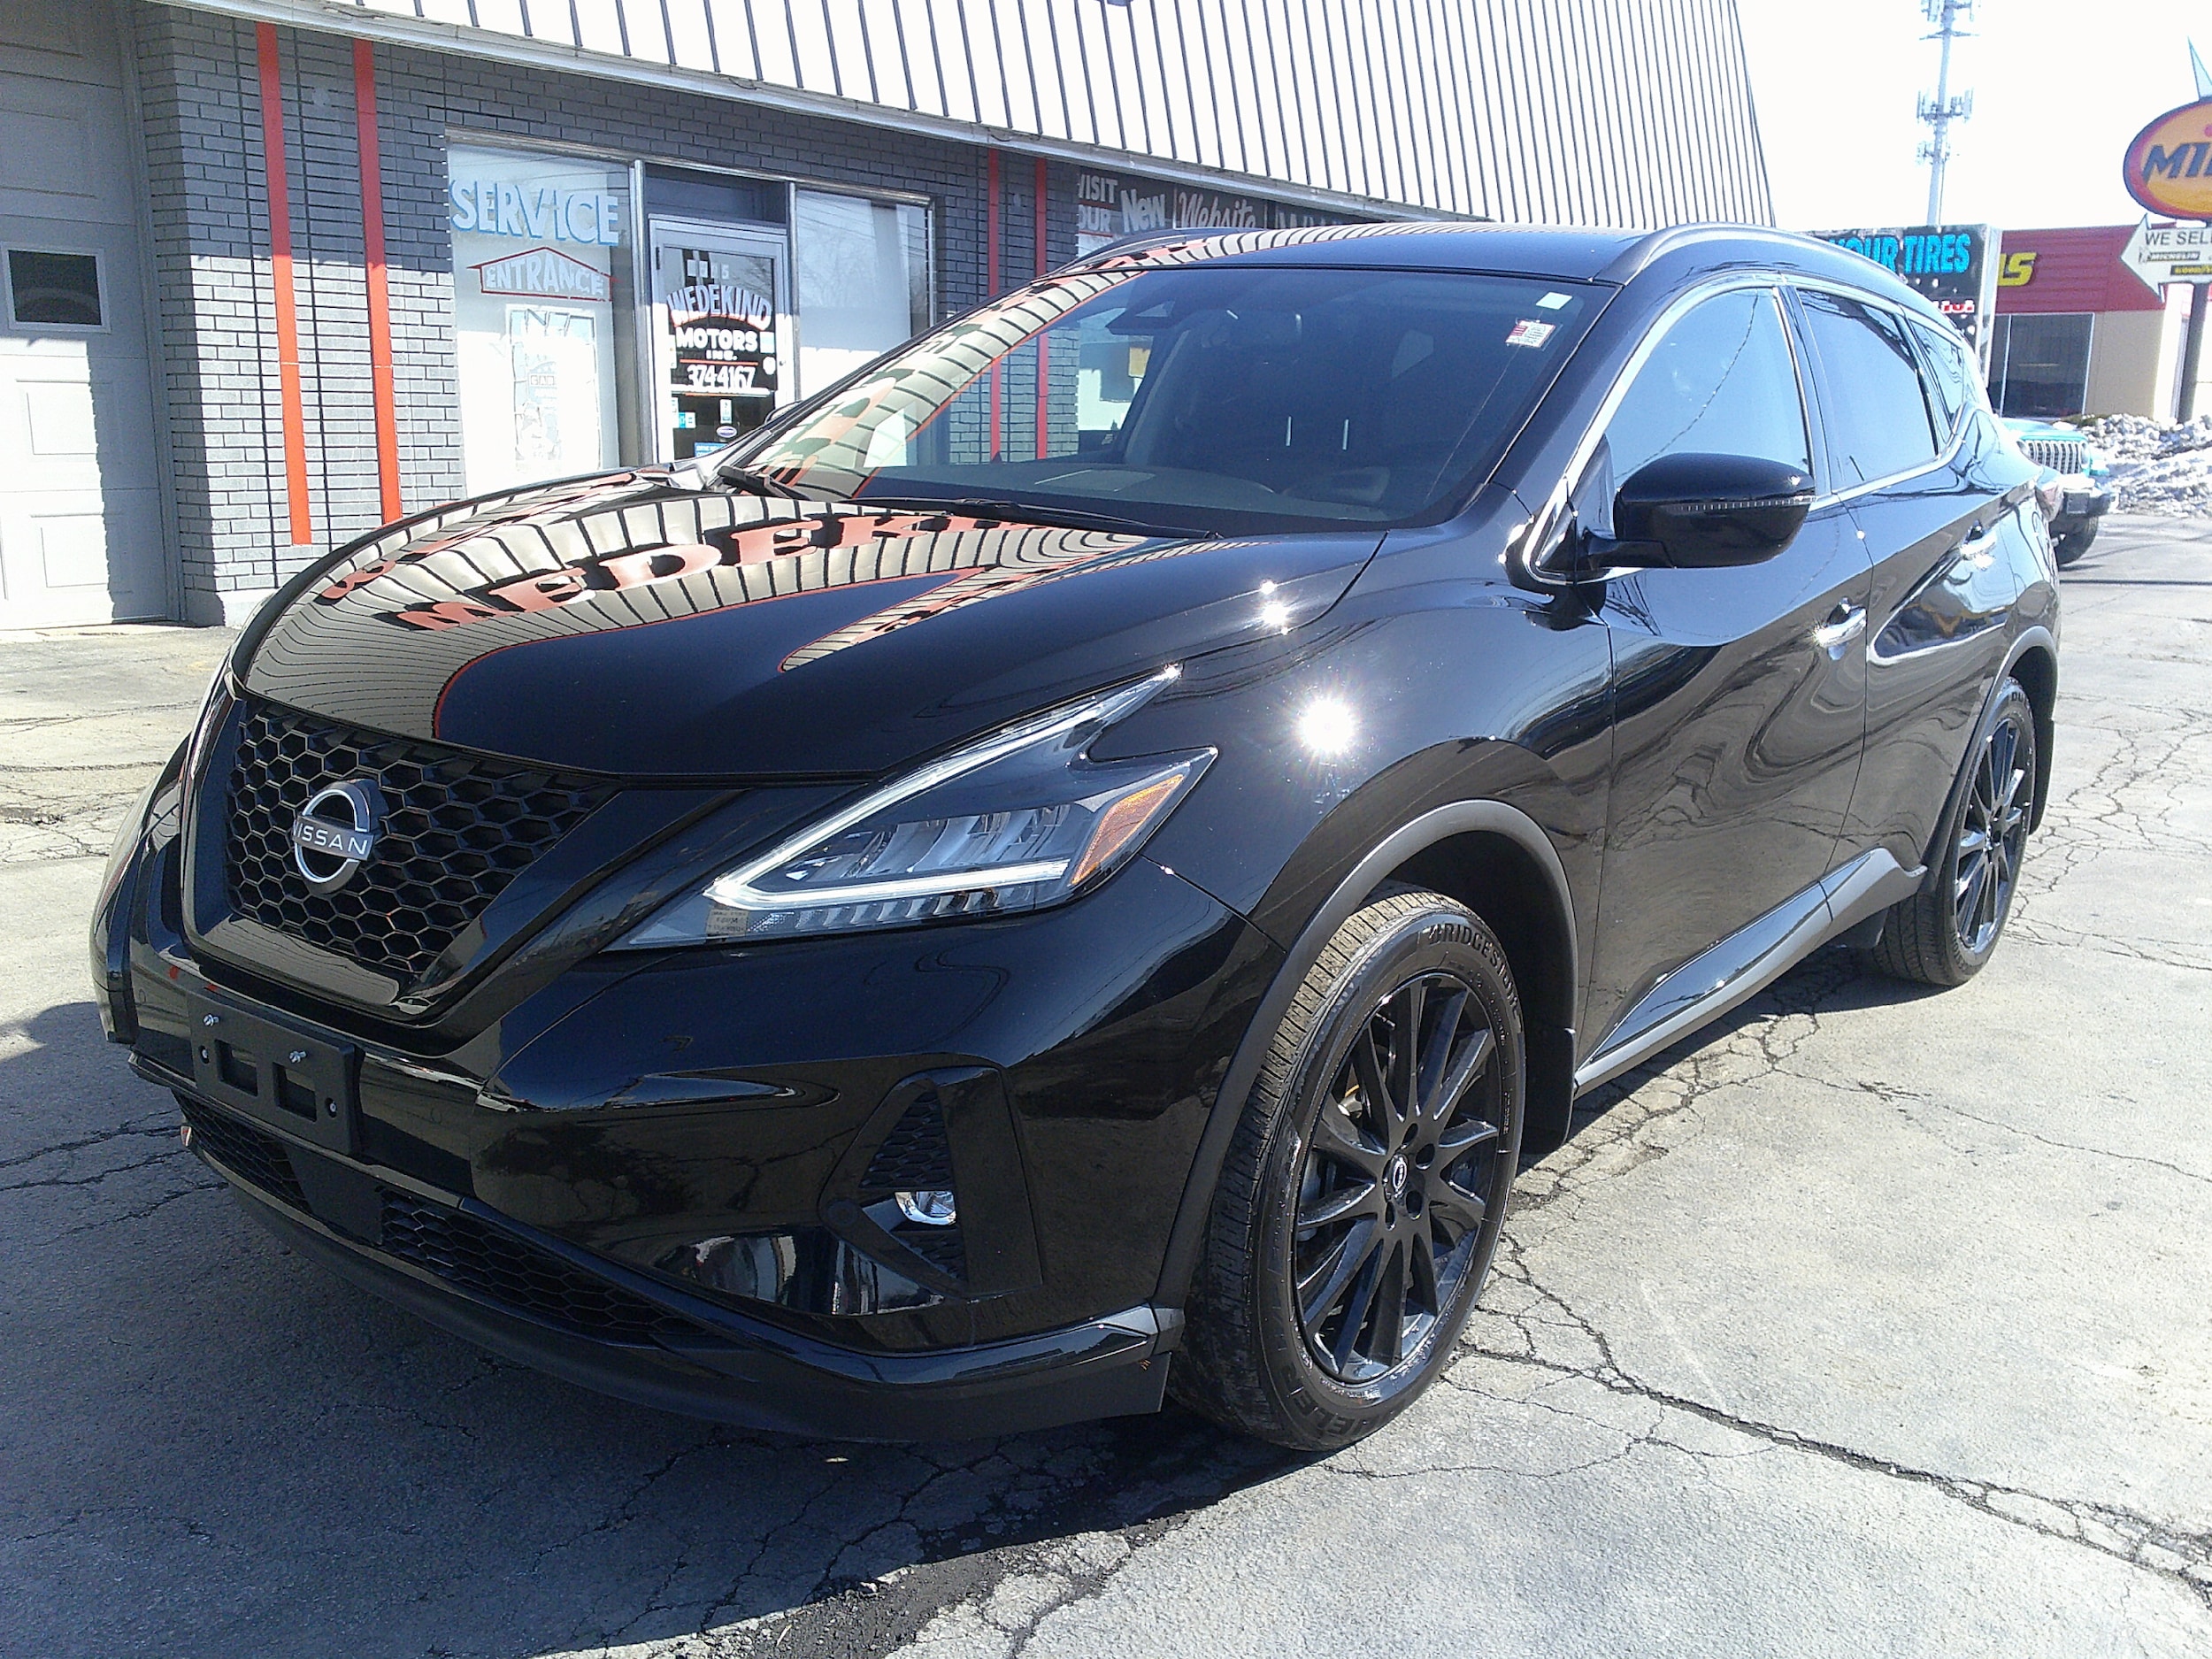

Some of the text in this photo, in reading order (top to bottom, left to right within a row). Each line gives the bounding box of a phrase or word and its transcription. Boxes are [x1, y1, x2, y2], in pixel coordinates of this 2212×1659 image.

[2142, 142, 2212, 183] MI
[449, 180, 619, 246] SERVICE
[1903, 234, 1970, 274] TIRES
[2145, 231, 2212, 245] WE SEL
[486, 253, 604, 296] ENTRANCE
[666, 284, 772, 331] WEDEKIND
[675, 326, 758, 352] MOTORS
[293, 819, 367, 855] NISSAN
[1428, 923, 1520, 1019] BRIDGESTONE
